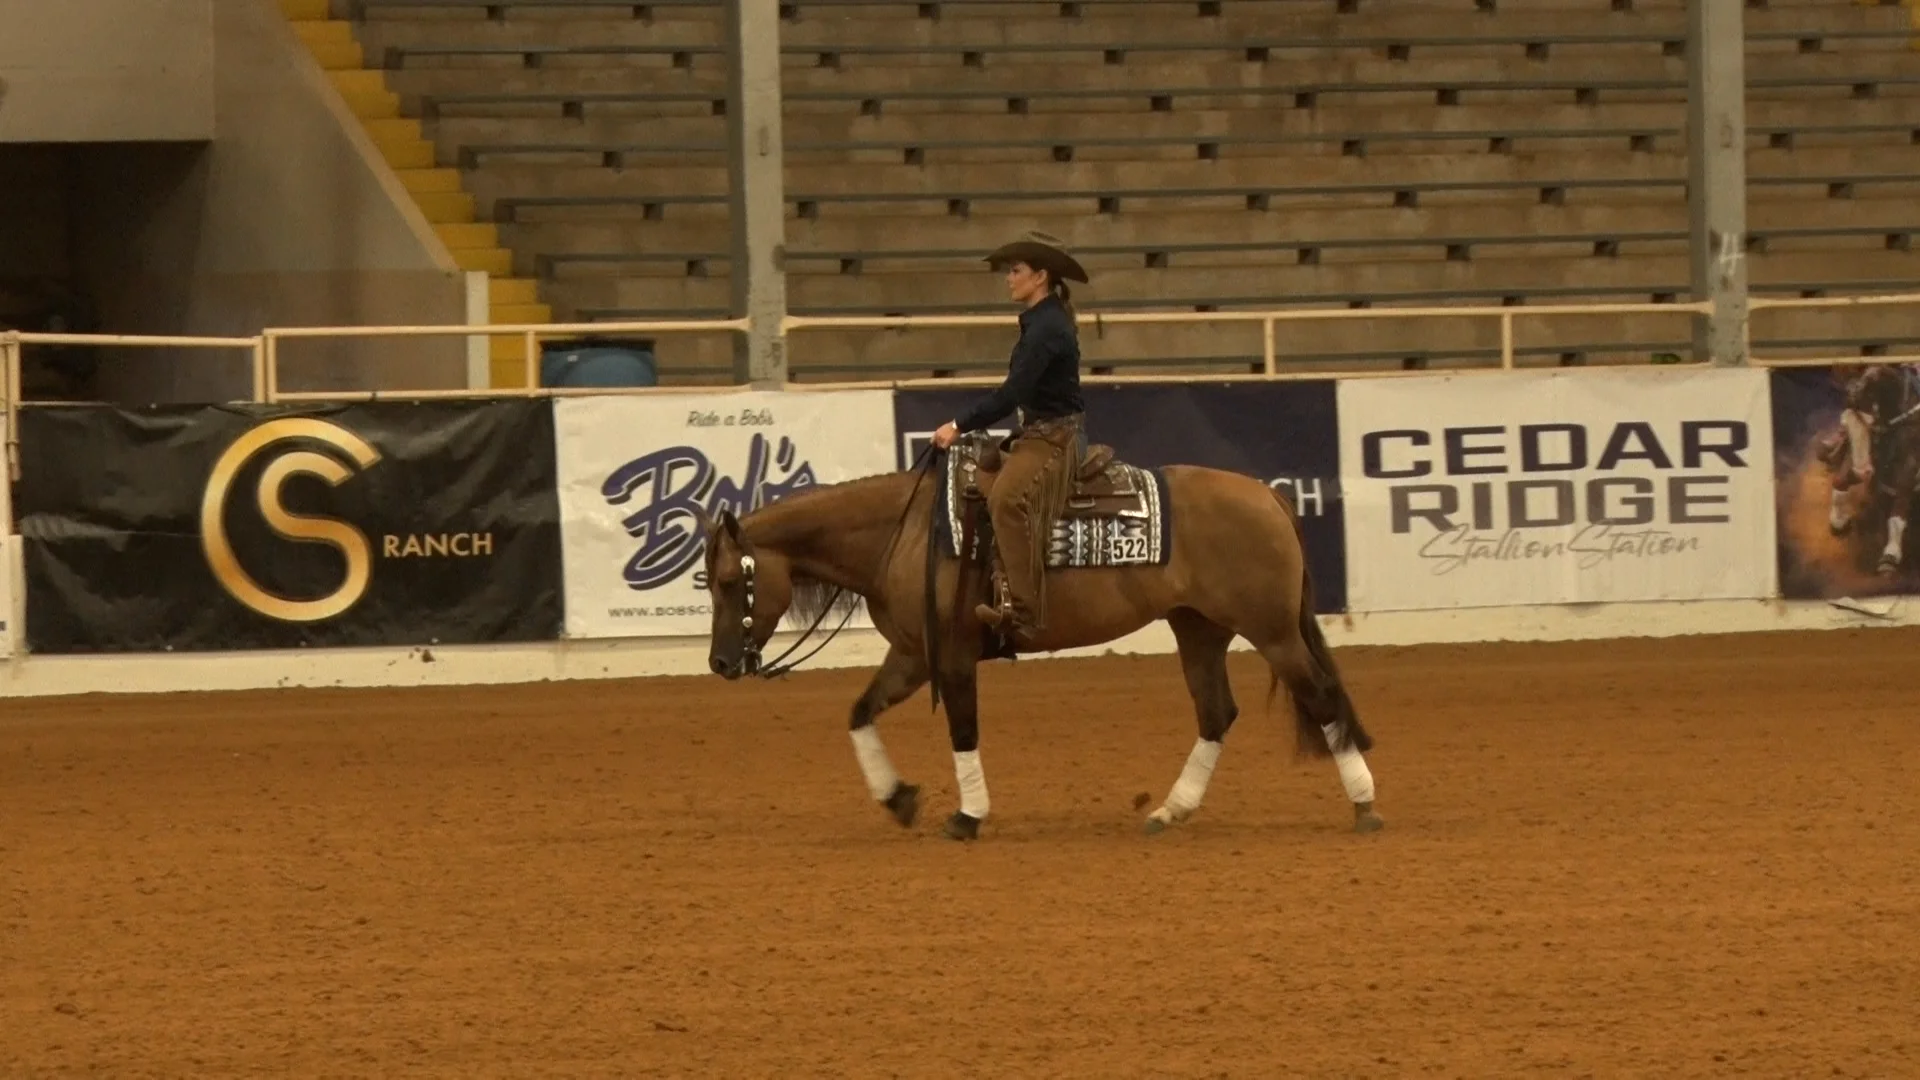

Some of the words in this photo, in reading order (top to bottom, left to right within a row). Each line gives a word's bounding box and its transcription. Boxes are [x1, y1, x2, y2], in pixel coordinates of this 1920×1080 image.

[686, 410, 721, 427] Ride
[723, 414, 735, 426] a
[1361, 420, 1750, 479] CEDAR
[1389, 475, 1730, 534] RIDGE
[383, 532, 493, 558] RANCH
[1113, 538, 1146, 559] 522
[1418, 523, 1565, 576] Stallion
[1566, 521, 1699, 570] Station
